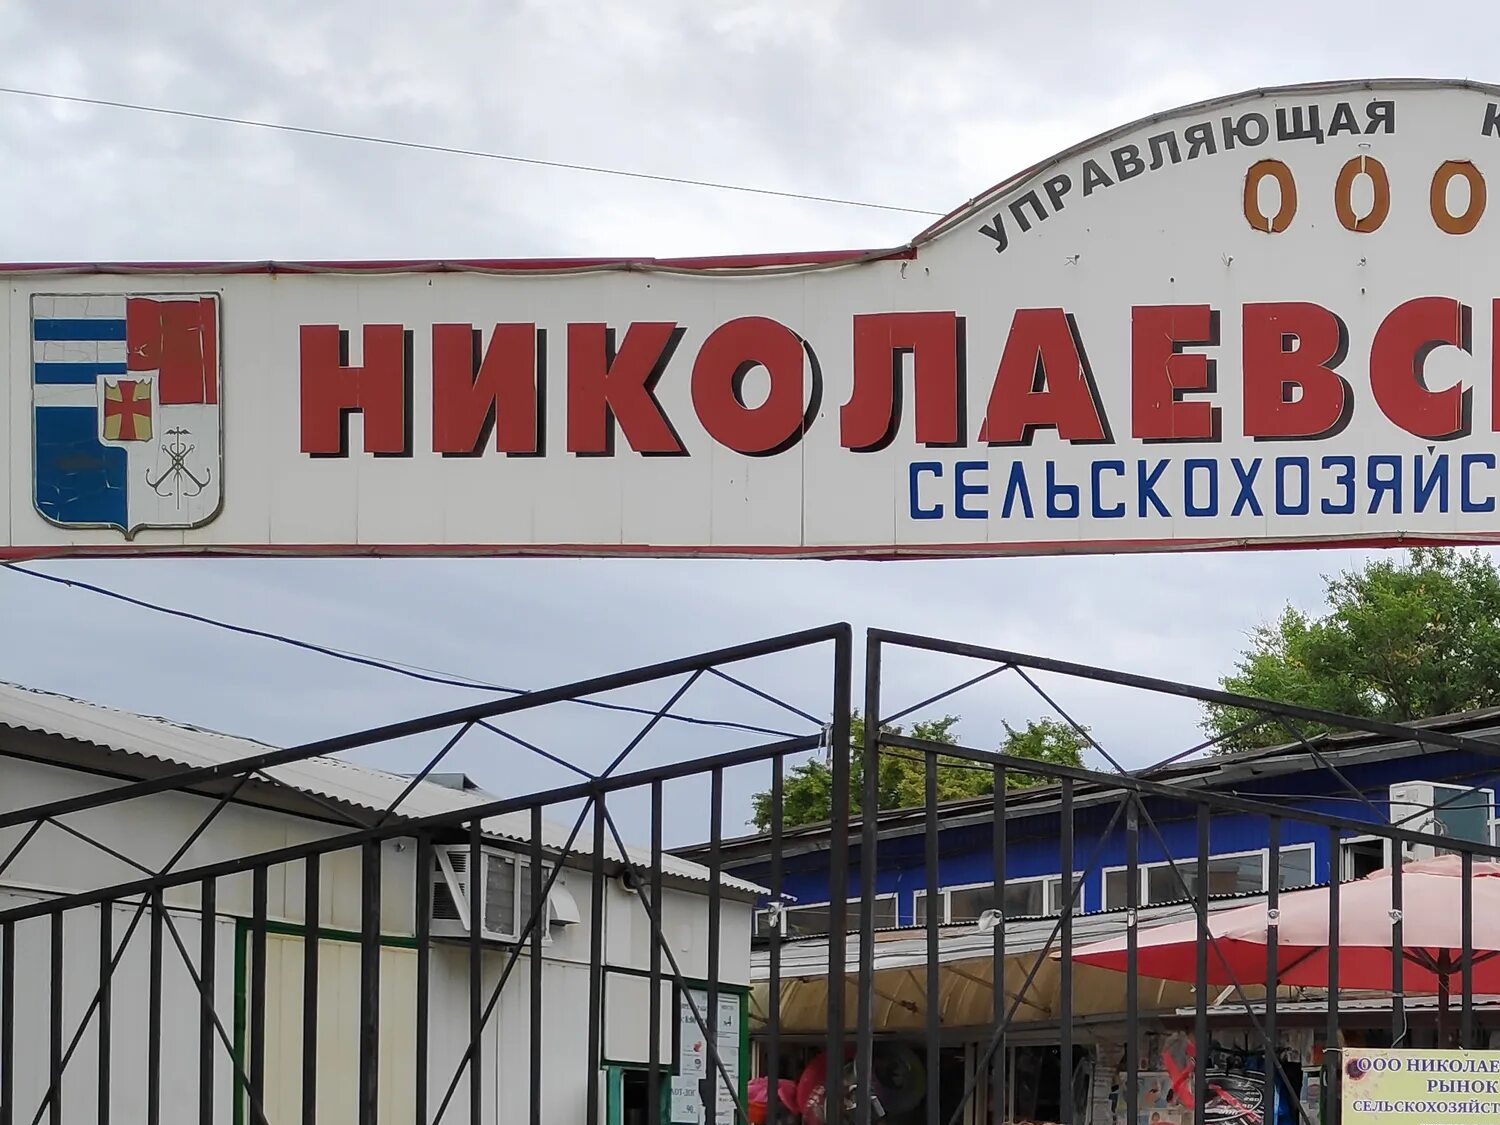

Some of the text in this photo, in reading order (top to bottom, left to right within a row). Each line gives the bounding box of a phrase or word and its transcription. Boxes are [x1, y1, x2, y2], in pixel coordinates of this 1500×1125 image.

[978, 100, 1396, 254] УПРАВЛЯЮЩАЯ
[1357, 1058, 1402, 1073] ООО
[1426, 1079, 1499, 1094] РЫНОК
